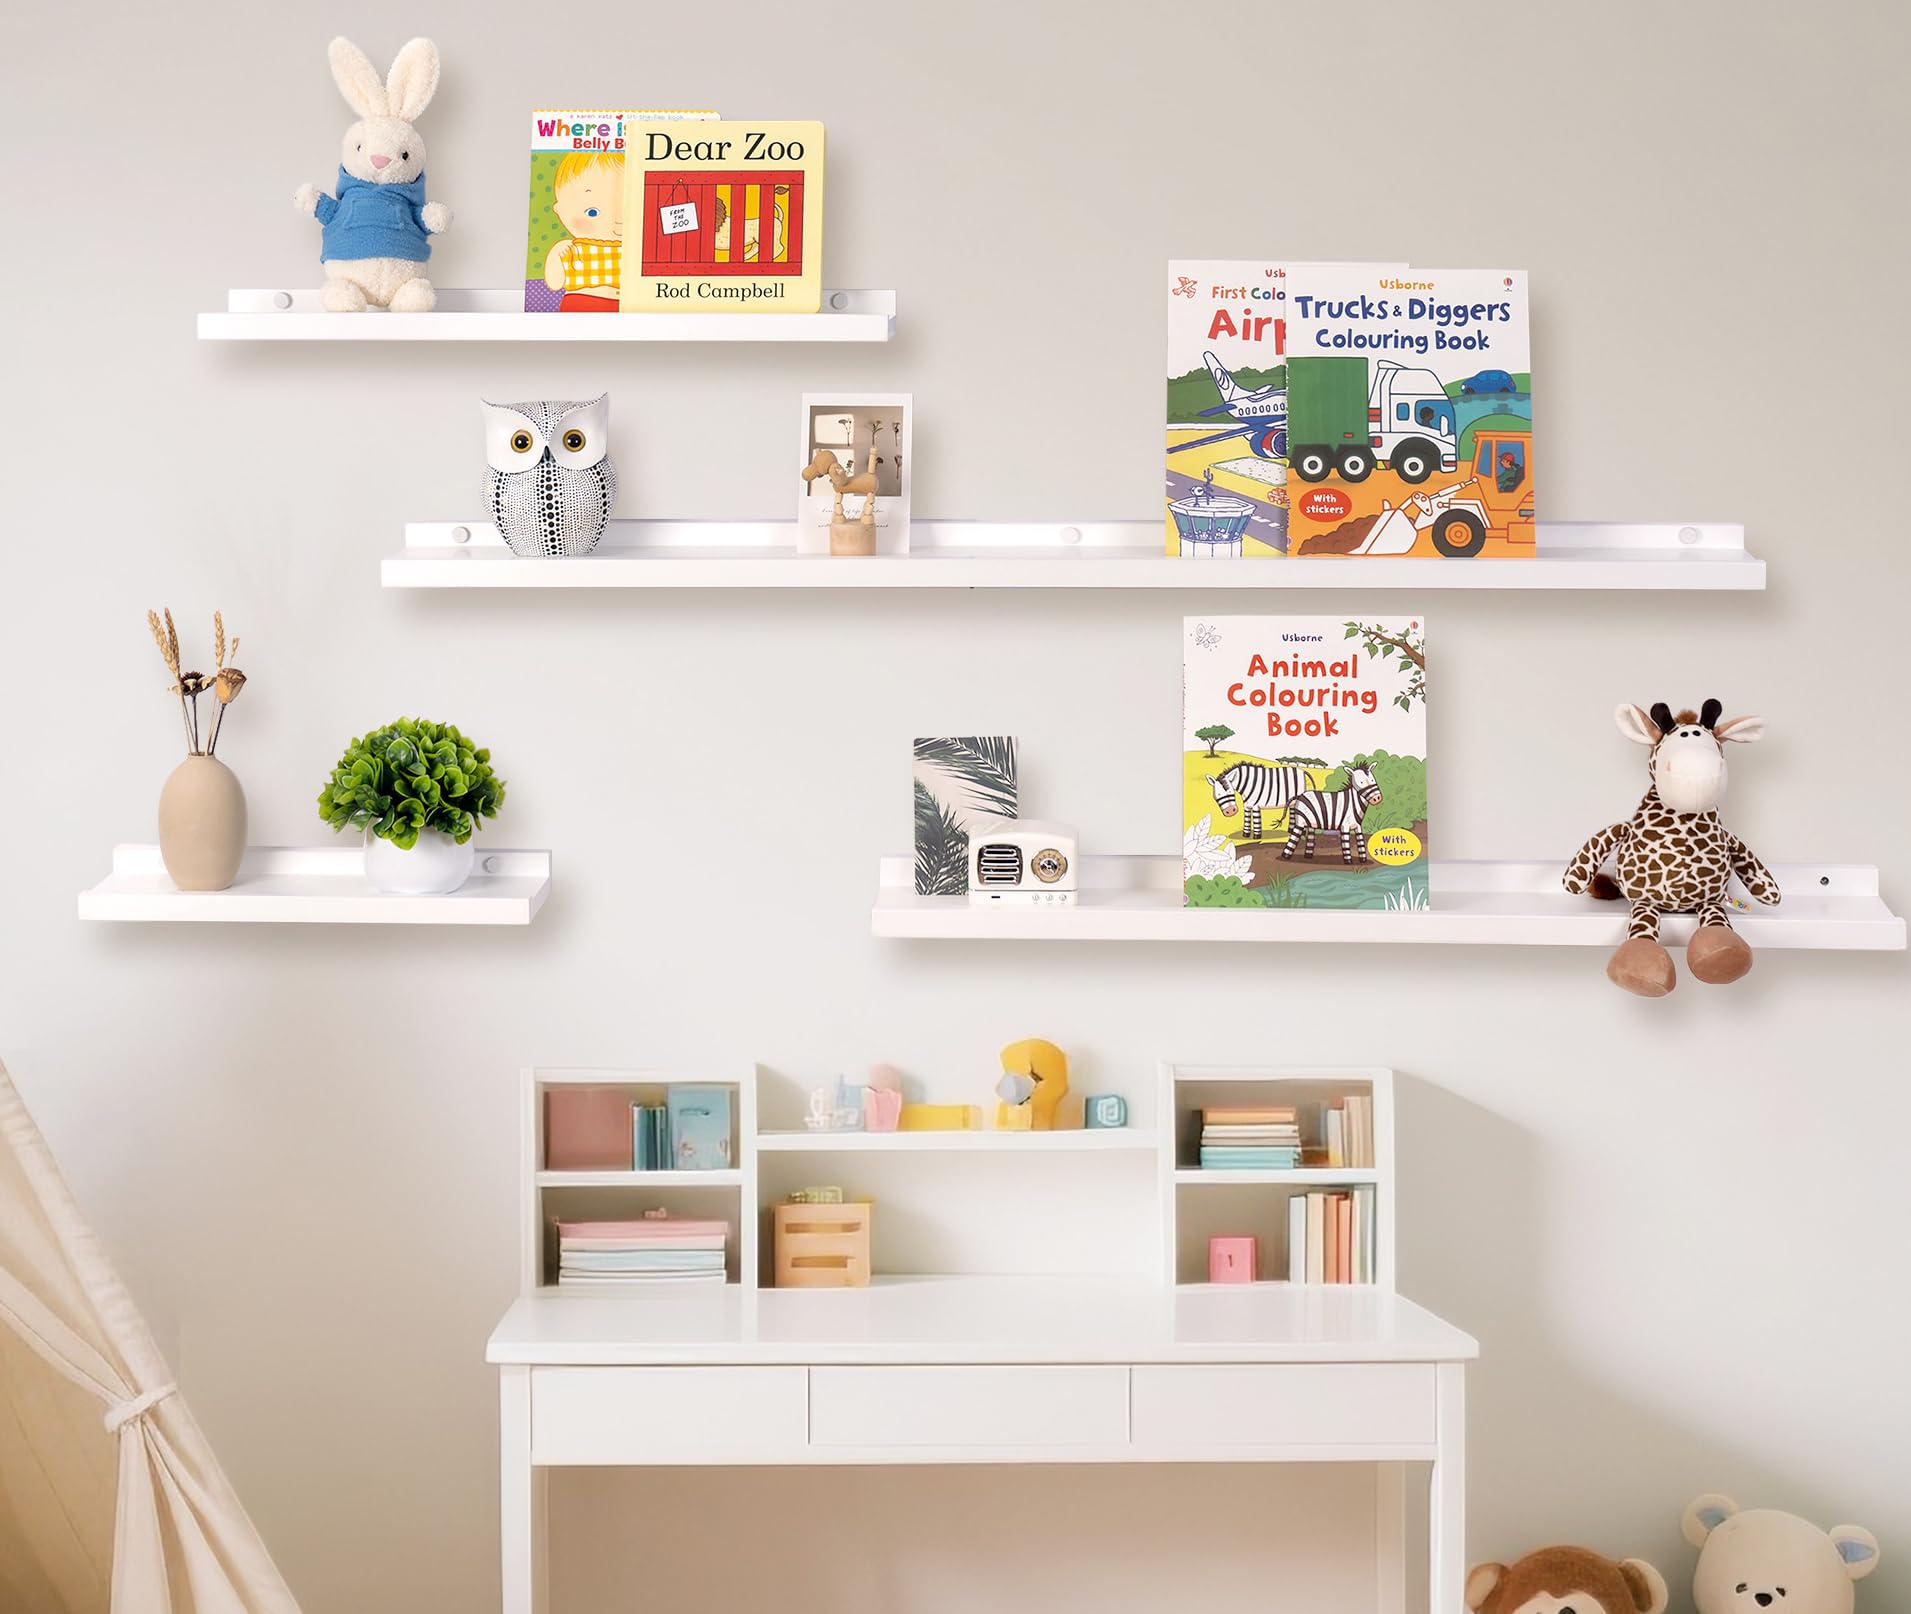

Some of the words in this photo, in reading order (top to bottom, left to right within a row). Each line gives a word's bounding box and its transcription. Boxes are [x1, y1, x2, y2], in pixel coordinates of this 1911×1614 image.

[537, 119, 611, 137] Where
[573, 137, 610, 152] Belly
[645, 133, 731, 161] Dear
[744, 133, 804, 161] Zoo
[672, 219, 689, 229] ZOO
[656, 283, 690, 298] Rod
[697, 283, 785, 301] Campbell
[1379, 279, 1435, 290] Usborne
[1212, 286, 1247, 299] First
[1251, 287, 1286, 300] Colo
[1295, 295, 1388, 320] Trucks
[1393, 305, 1402, 317] &
[1408, 297, 1511, 327] Diggers
[1316, 328, 1428, 354] Colouring
[1435, 330, 1490, 350] Book
[1313, 494, 1337, 503] With
[1305, 505, 1344, 514] stickers
[1282, 633, 1323, 642] Usborne
[1247, 653, 1358, 679] Animal
[1227, 682, 1378, 714] Colouring
[1267, 711, 1339, 737] Book
[1382, 835, 1406, 844] With
[1374, 847, 1414, 856] stickers
